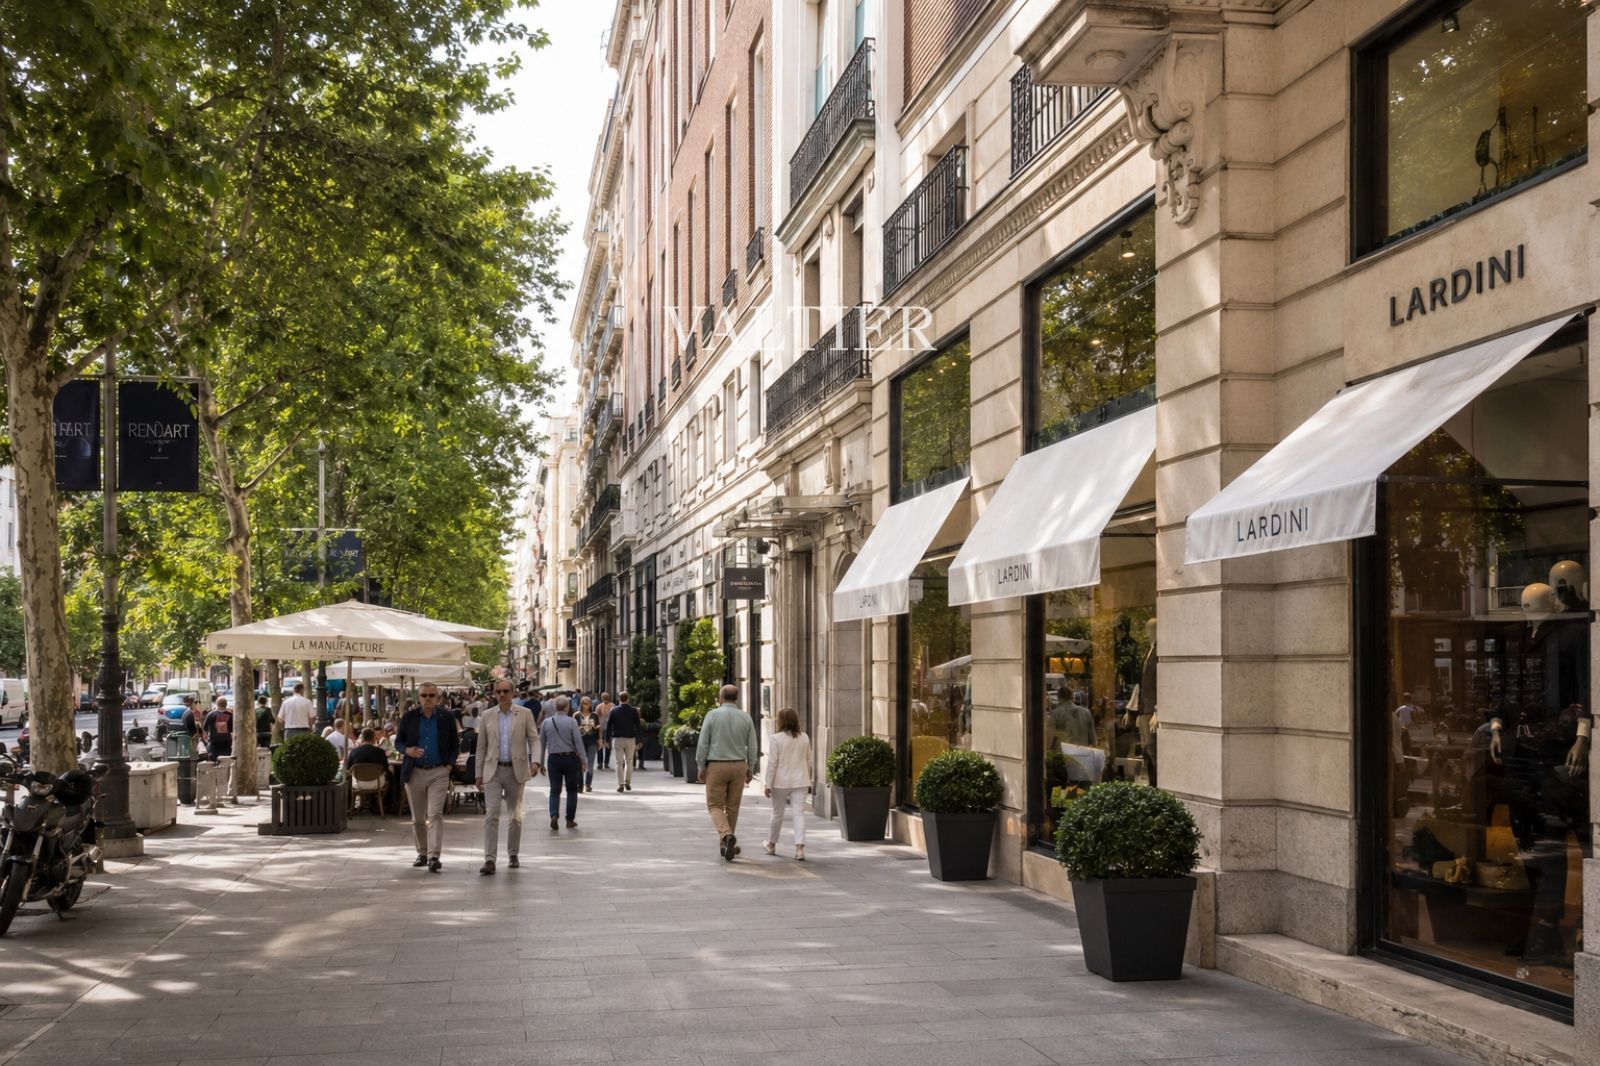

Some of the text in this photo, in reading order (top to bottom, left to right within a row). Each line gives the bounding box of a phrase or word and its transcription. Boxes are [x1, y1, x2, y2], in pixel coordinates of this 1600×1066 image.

[1389, 243, 1525, 327] LARDINI
[1237, 507, 1309, 543] LARDINI
[997, 562, 1032, 585] LARDINI
[292, 639, 385, 653] LA MANUFACTURE
